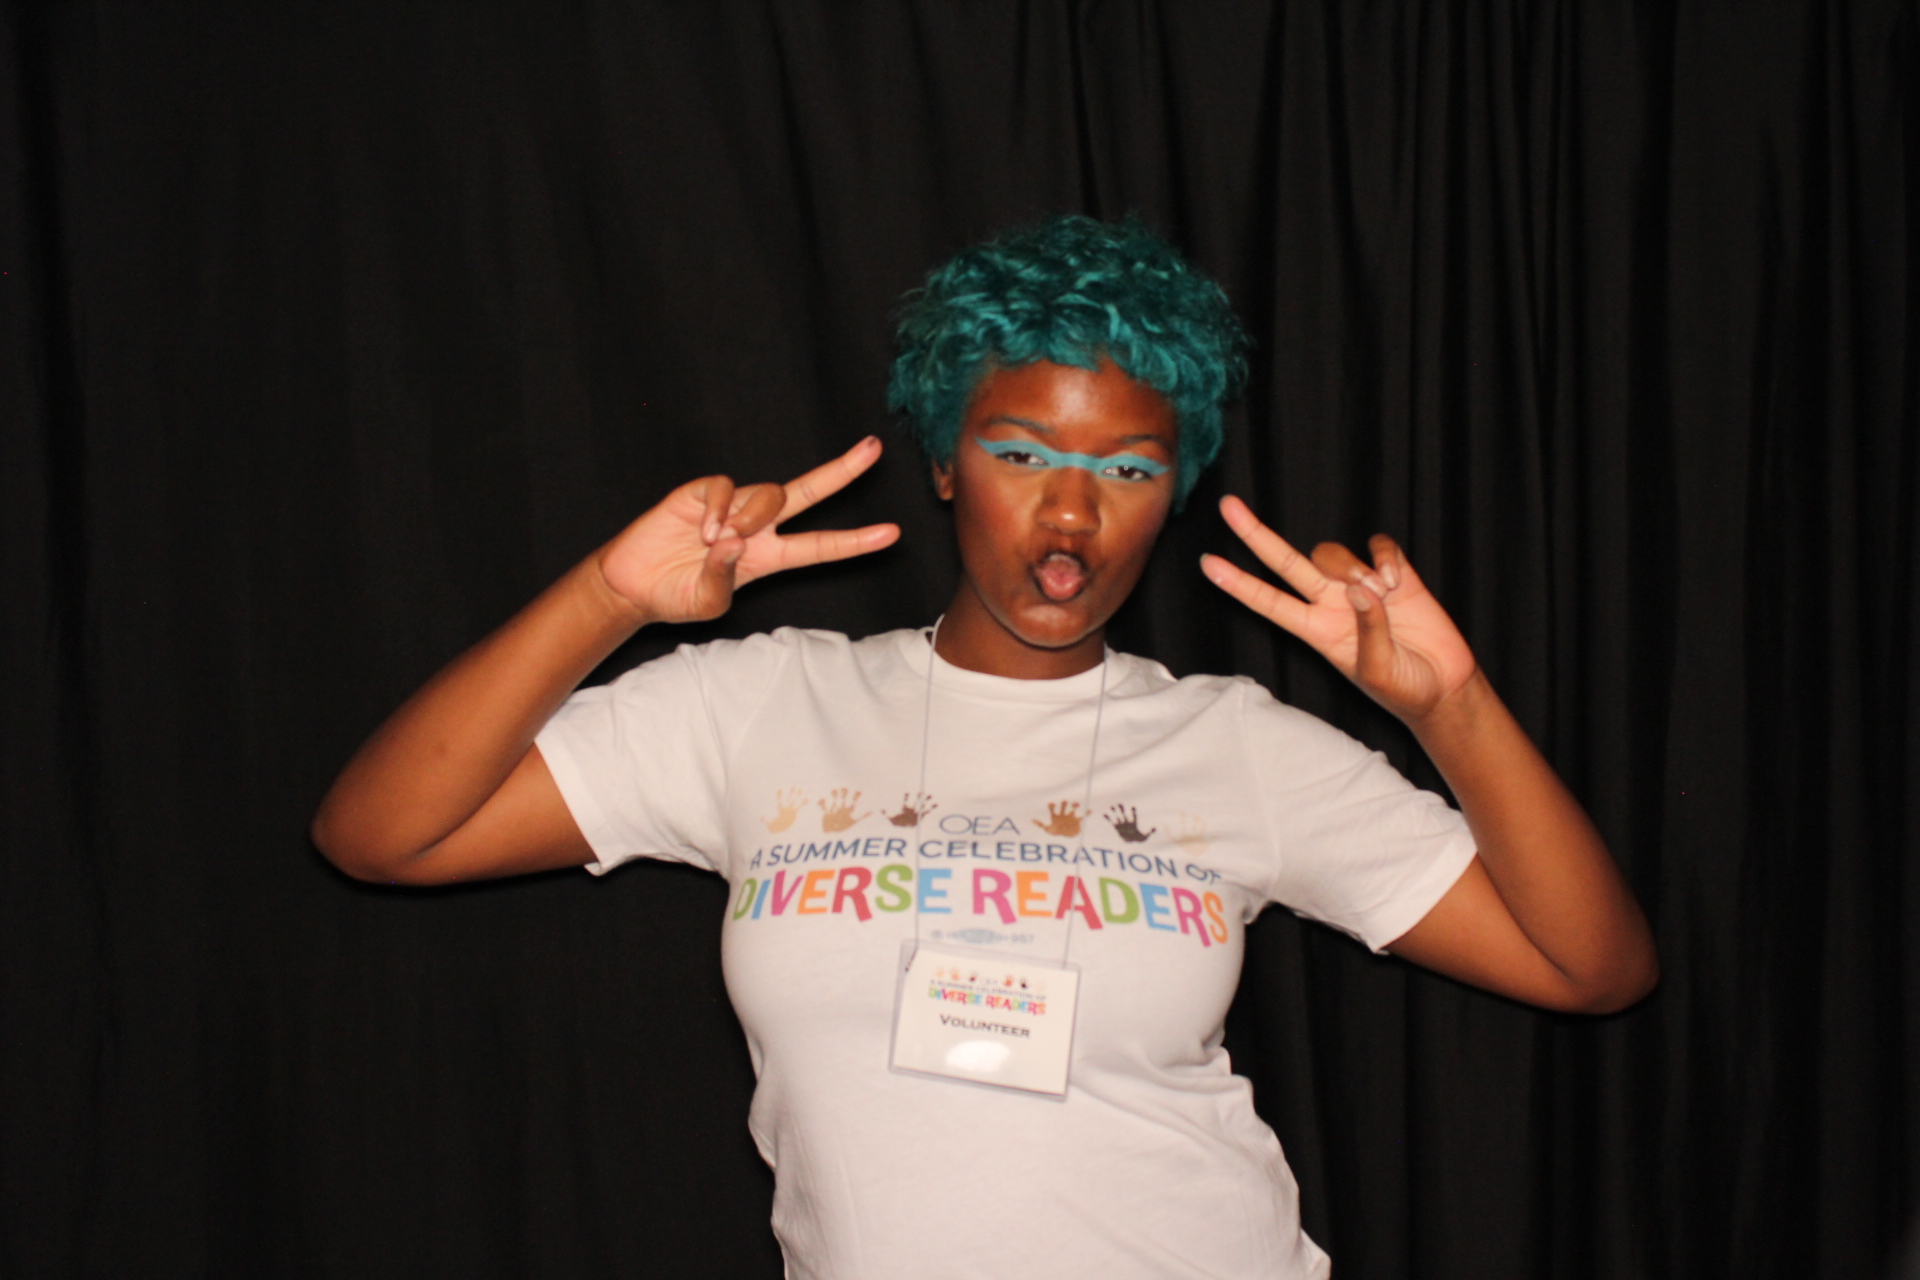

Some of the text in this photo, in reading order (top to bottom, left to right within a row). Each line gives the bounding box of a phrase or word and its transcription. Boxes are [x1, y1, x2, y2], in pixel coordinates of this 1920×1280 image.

[940, 813, 1021, 837] OEA
[750, 848, 763, 871] A
[767, 838, 907, 867] SUMMER
[919, 840, 1178, 879] CELEBRATION
[732, 864, 1229, 948] DIVERSE READERS
[929, 987, 1046, 1015] DIVERSE READERS
